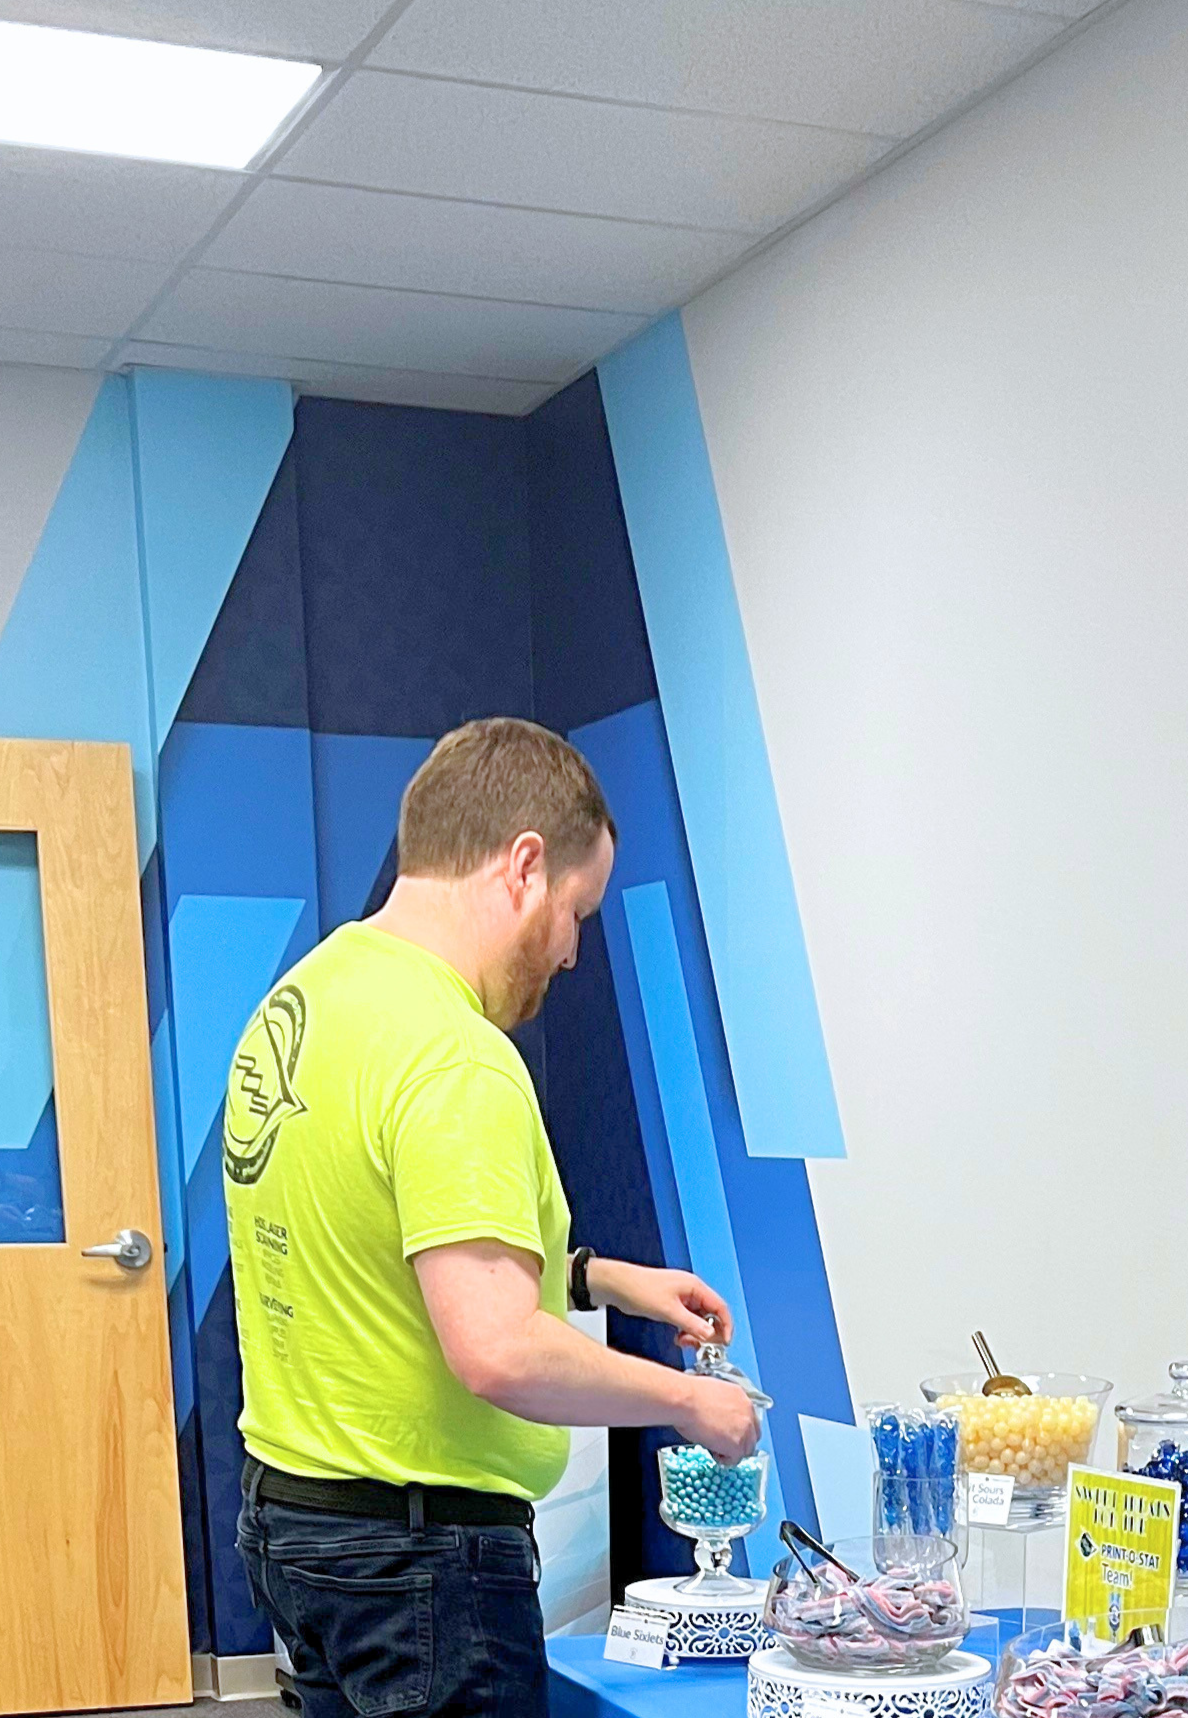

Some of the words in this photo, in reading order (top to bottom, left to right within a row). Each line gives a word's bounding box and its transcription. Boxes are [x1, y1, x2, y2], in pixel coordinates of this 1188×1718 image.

[978, 1482, 1004, 1495] Sours
[973, 1494, 1004, 1506] Colada
[1101, 1543, 1160, 1570] PRINT-O-STAT
[610, 1625, 632, 1640] Blue
[633, 1629, 664, 1645] Sixlets
